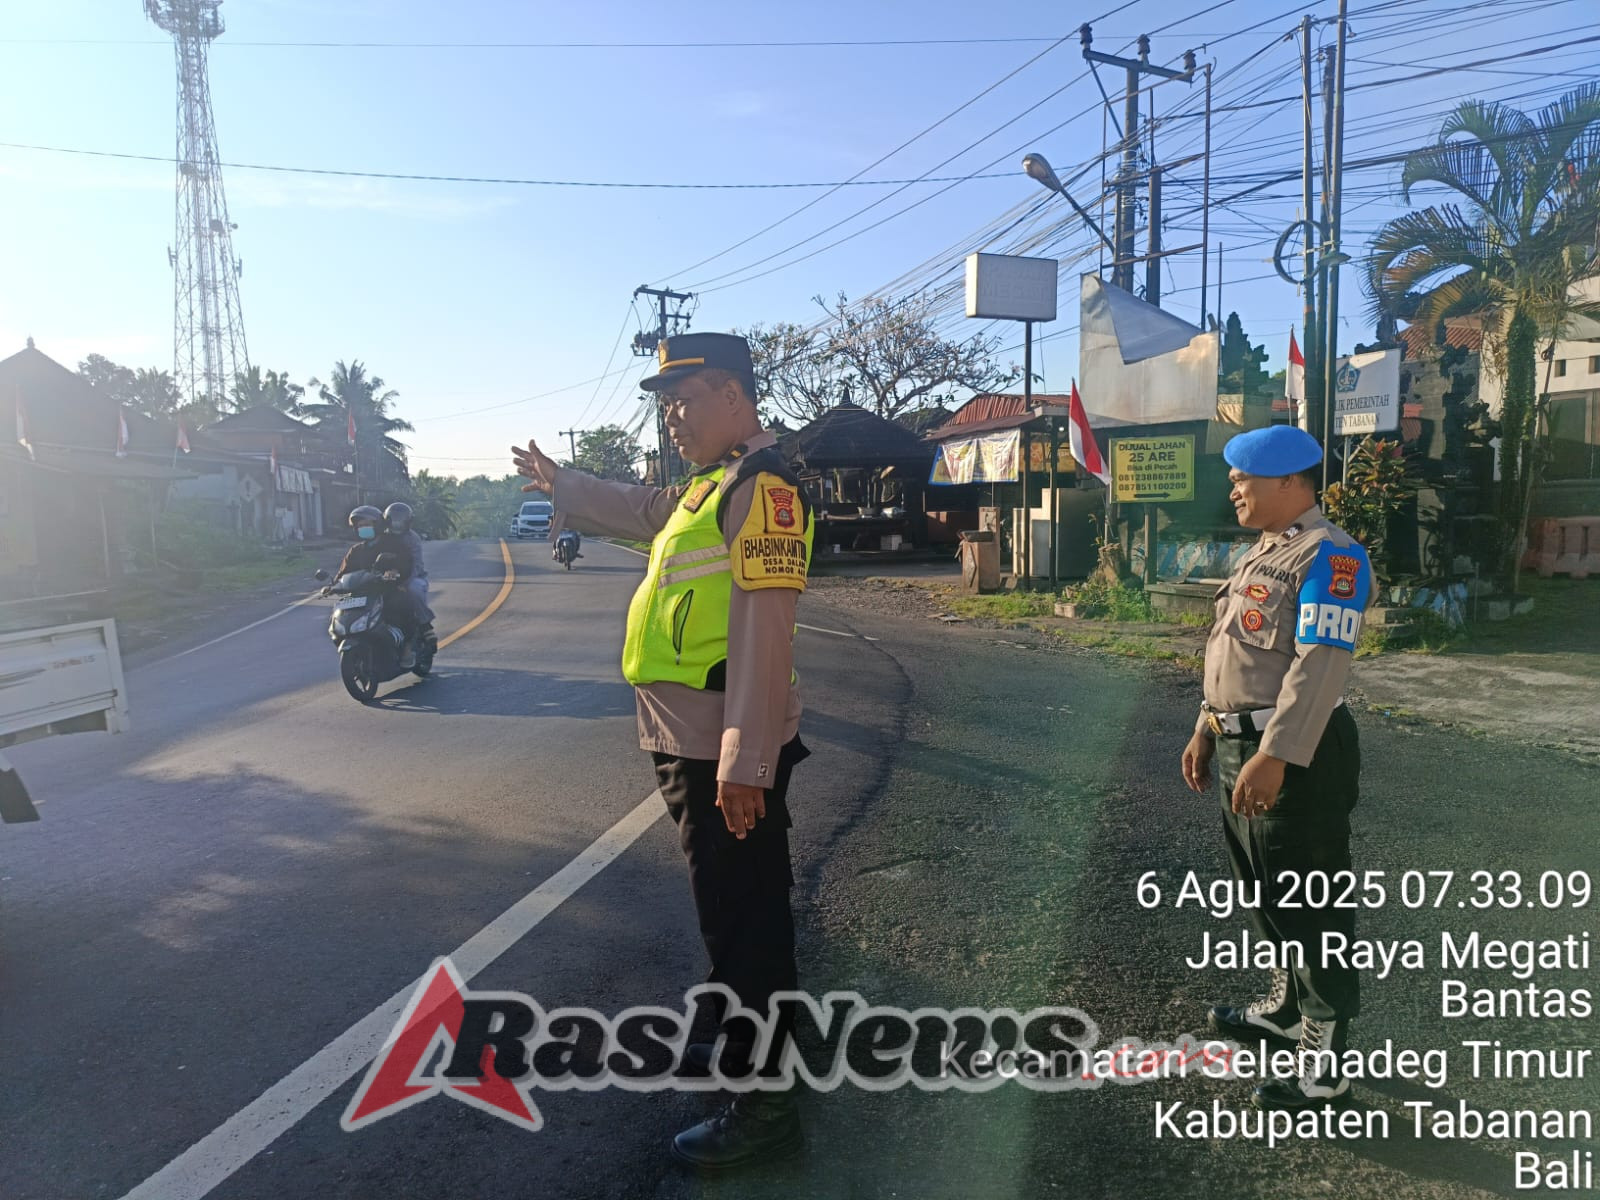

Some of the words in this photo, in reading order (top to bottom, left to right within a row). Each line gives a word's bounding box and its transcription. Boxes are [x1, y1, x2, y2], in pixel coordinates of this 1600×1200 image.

[1346, 394, 1390, 410] PEMERINTAH
[1118, 443, 1151, 452] DIJUAL
[1153, 441, 1186, 449] LAHAN
[1129, 452, 1145, 462] 25
[1149, 451, 1176, 461] ARE
[763, 558, 783, 566] DESA
[1299, 602, 1362, 643] PRO
